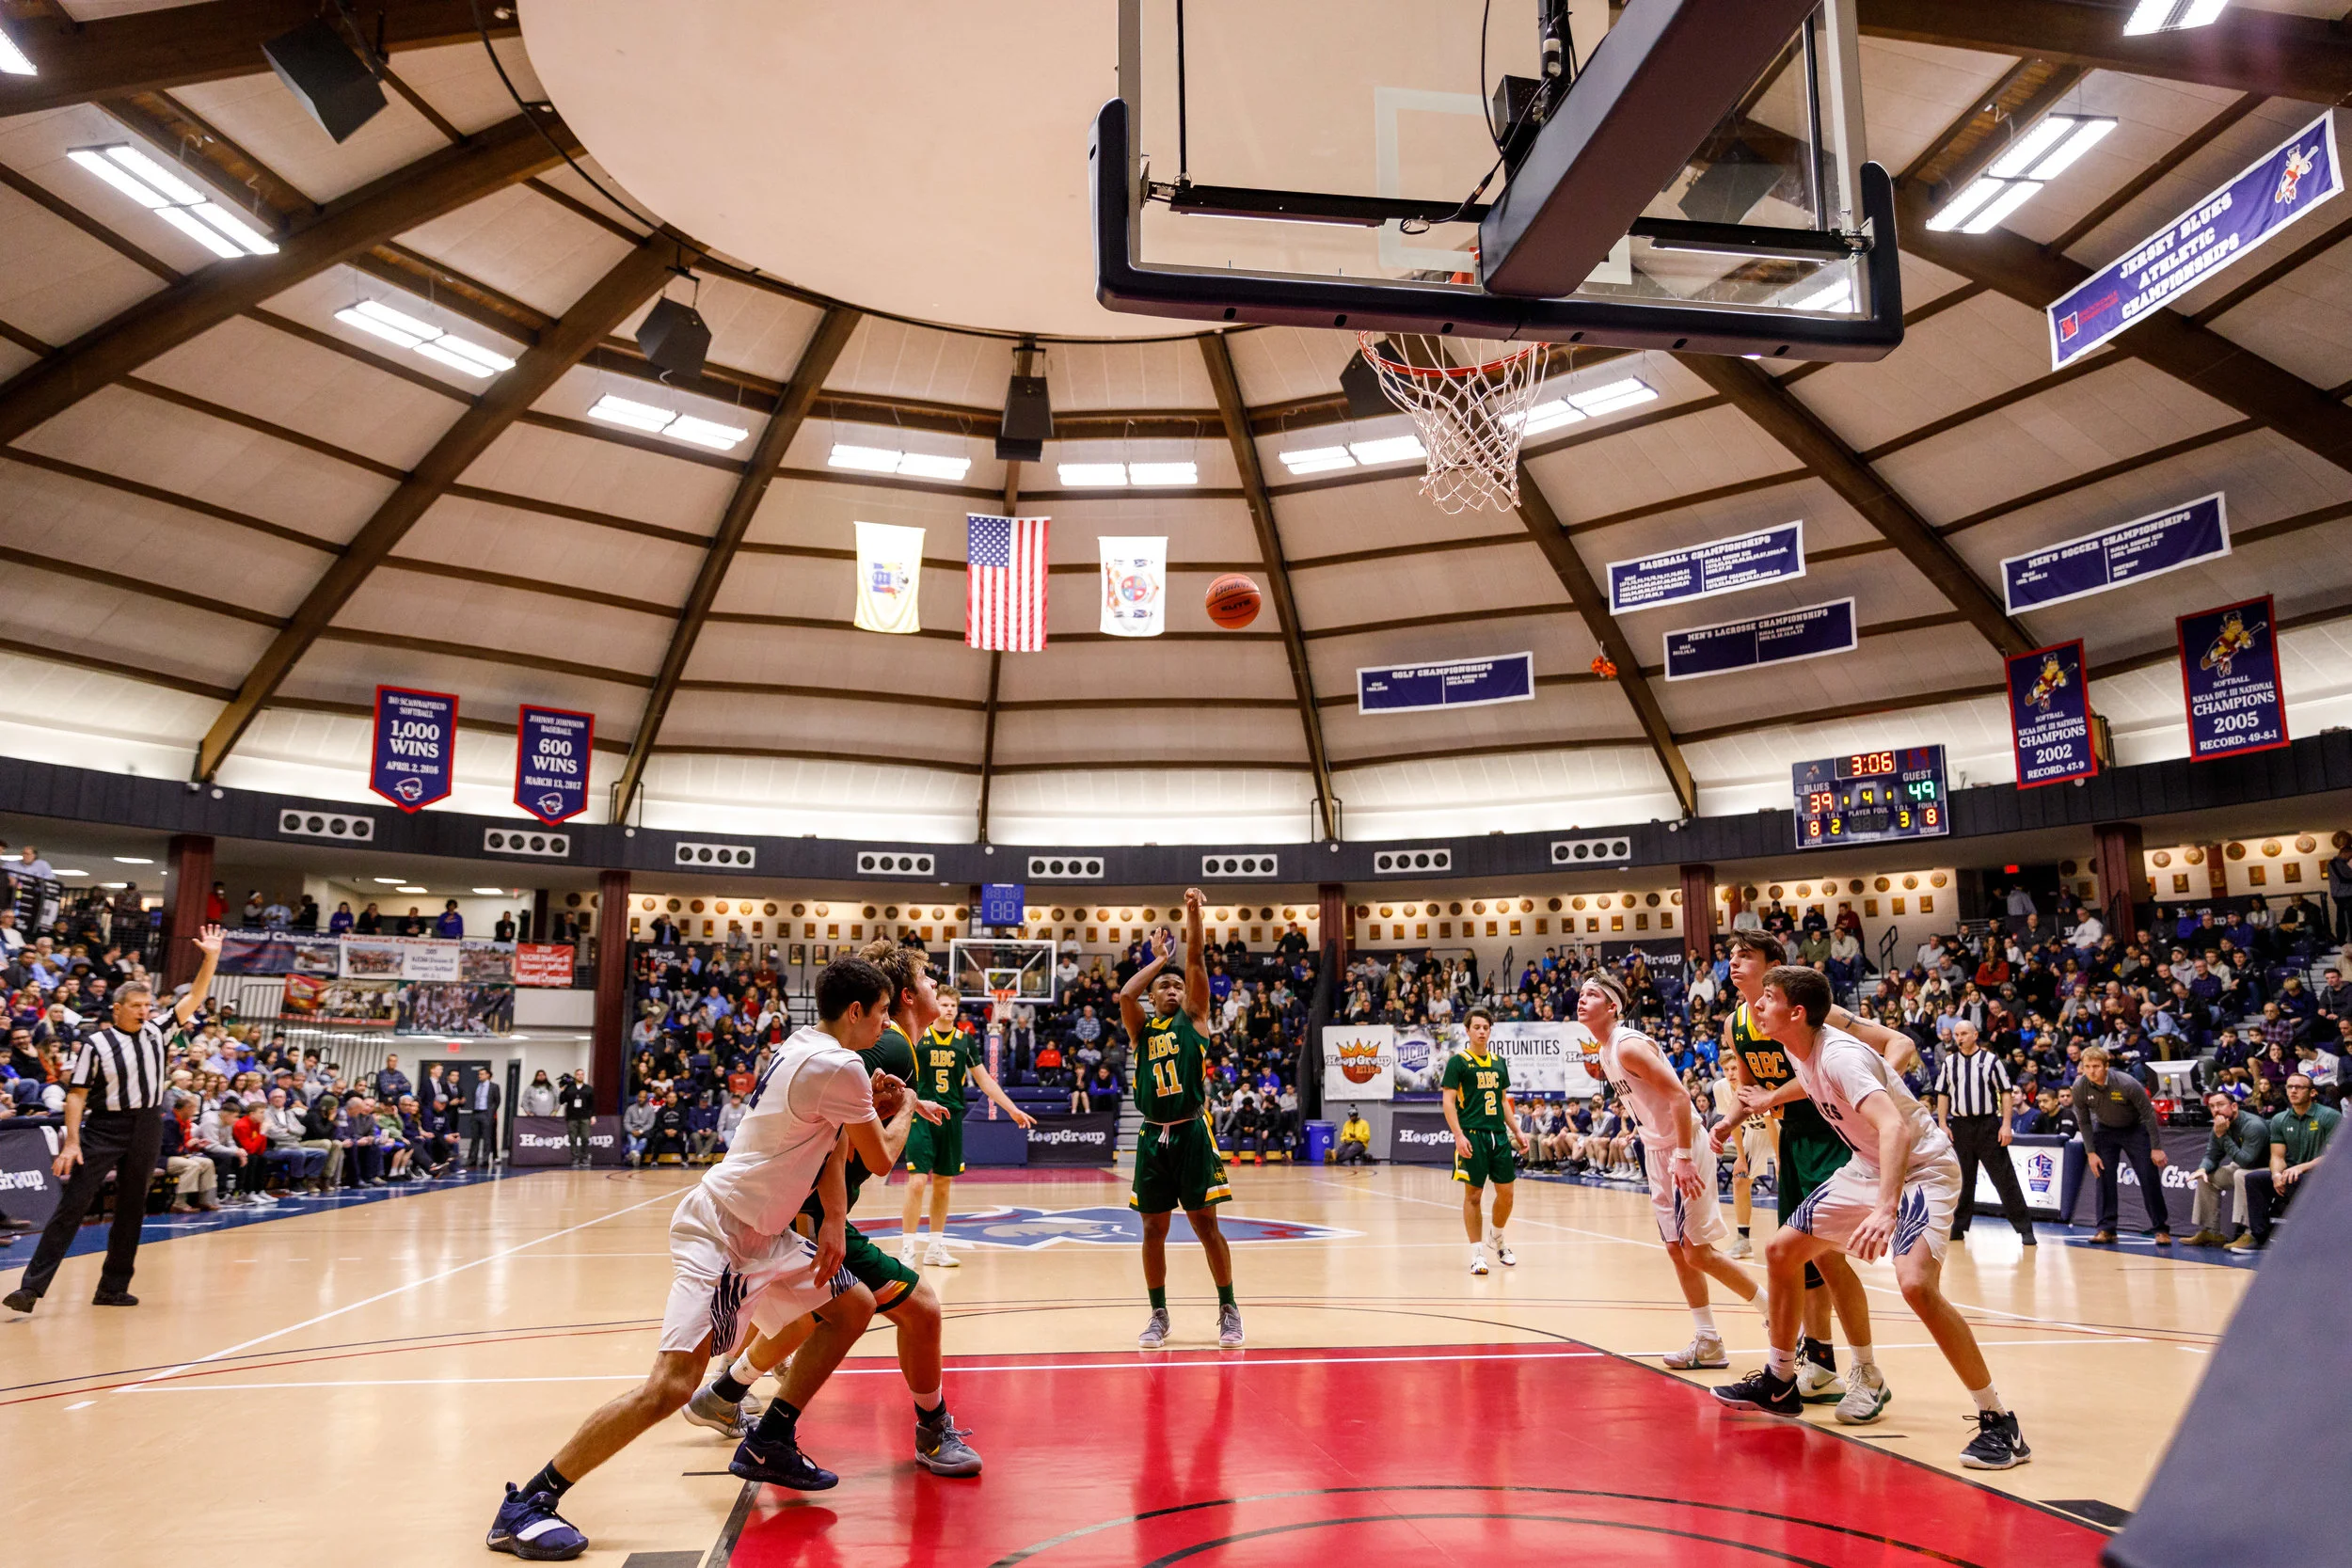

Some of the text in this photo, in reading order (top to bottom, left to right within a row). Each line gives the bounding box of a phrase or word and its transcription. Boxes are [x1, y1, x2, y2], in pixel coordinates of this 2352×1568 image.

[2119, 192, 2233, 278] JERSEY BLUES
[2138, 227, 2215, 290] ATHLETIC
[2122, 233, 2239, 320] CHAMPIONSHIPS
[2028, 553, 2058, 569] MEN'S
[2061, 541, 2099, 559] SOCCER
[2102, 512, 2191, 546] CHAMPIONSHIPS
[1639, 553, 1689, 572] BASEBALL
[1691, 535, 1772, 560] CHAMPIONSHIPS
[1688, 631, 1712, 641] MEN'S
[1715, 624, 1756, 637] LACROSSE
[1759, 609, 1828, 628] CHAMPIONSHIPS
[1391, 662, 1493, 679] GOLF CHAMPIONSHIPS
[2213, 674, 2250, 689] SOFTBALL
[2192, 681, 2274, 704] NJCAA DIV. III NATIONAL
[2193, 690, 2276, 717] CHAMPIONS
[2035, 711, 2065, 723] SOFTBALL
[2214, 710, 2260, 734] 2005
[390, 720, 440, 740] 1,000
[2019, 724, 2087, 748] CHAMPIONS
[2200, 729, 2278, 751] RECORD: 49-8-1
[389, 737, 439, 758] WINS
[538, 737, 573, 756] 600
[2036, 743, 2073, 765] 2002
[385, 760, 410, 772] APRIL
[532, 755, 578, 774] WINS
[1851, 752, 1894, 776] 3:06
[2027, 760, 2086, 780] RECORD: 47-9
[524, 775, 553, 788] MARCH
[1902, 769, 1932, 782] GUEST
[1804, 783, 1830, 793] BLUES
[1862, 791, 1873, 804] 4
[1908, 780, 1936, 801] 49
[1809, 792, 1834, 815] 39
[1803, 813, 1821, 822] FOULS
[1831, 818, 1841, 834] 2
[1900, 811, 1910, 828] 3
[1926, 808, 1937, 825] 8
[1809, 820, 1820, 836] 8
[1919, 826, 1940, 834] SCORE
[1804, 837, 1822, 846] SCORE
[225, 927, 271, 941] ational
[1465, 1039, 1560, 1055] OORTUNITIES
[935, 1069, 949, 1093] 5
[988, 1037, 999, 1120] BROOKLE
[1152, 1059, 1184, 1098] 11
[1484, 1090, 1497, 1116] 2
[1399, 1129, 1455, 1146] HoopGr
